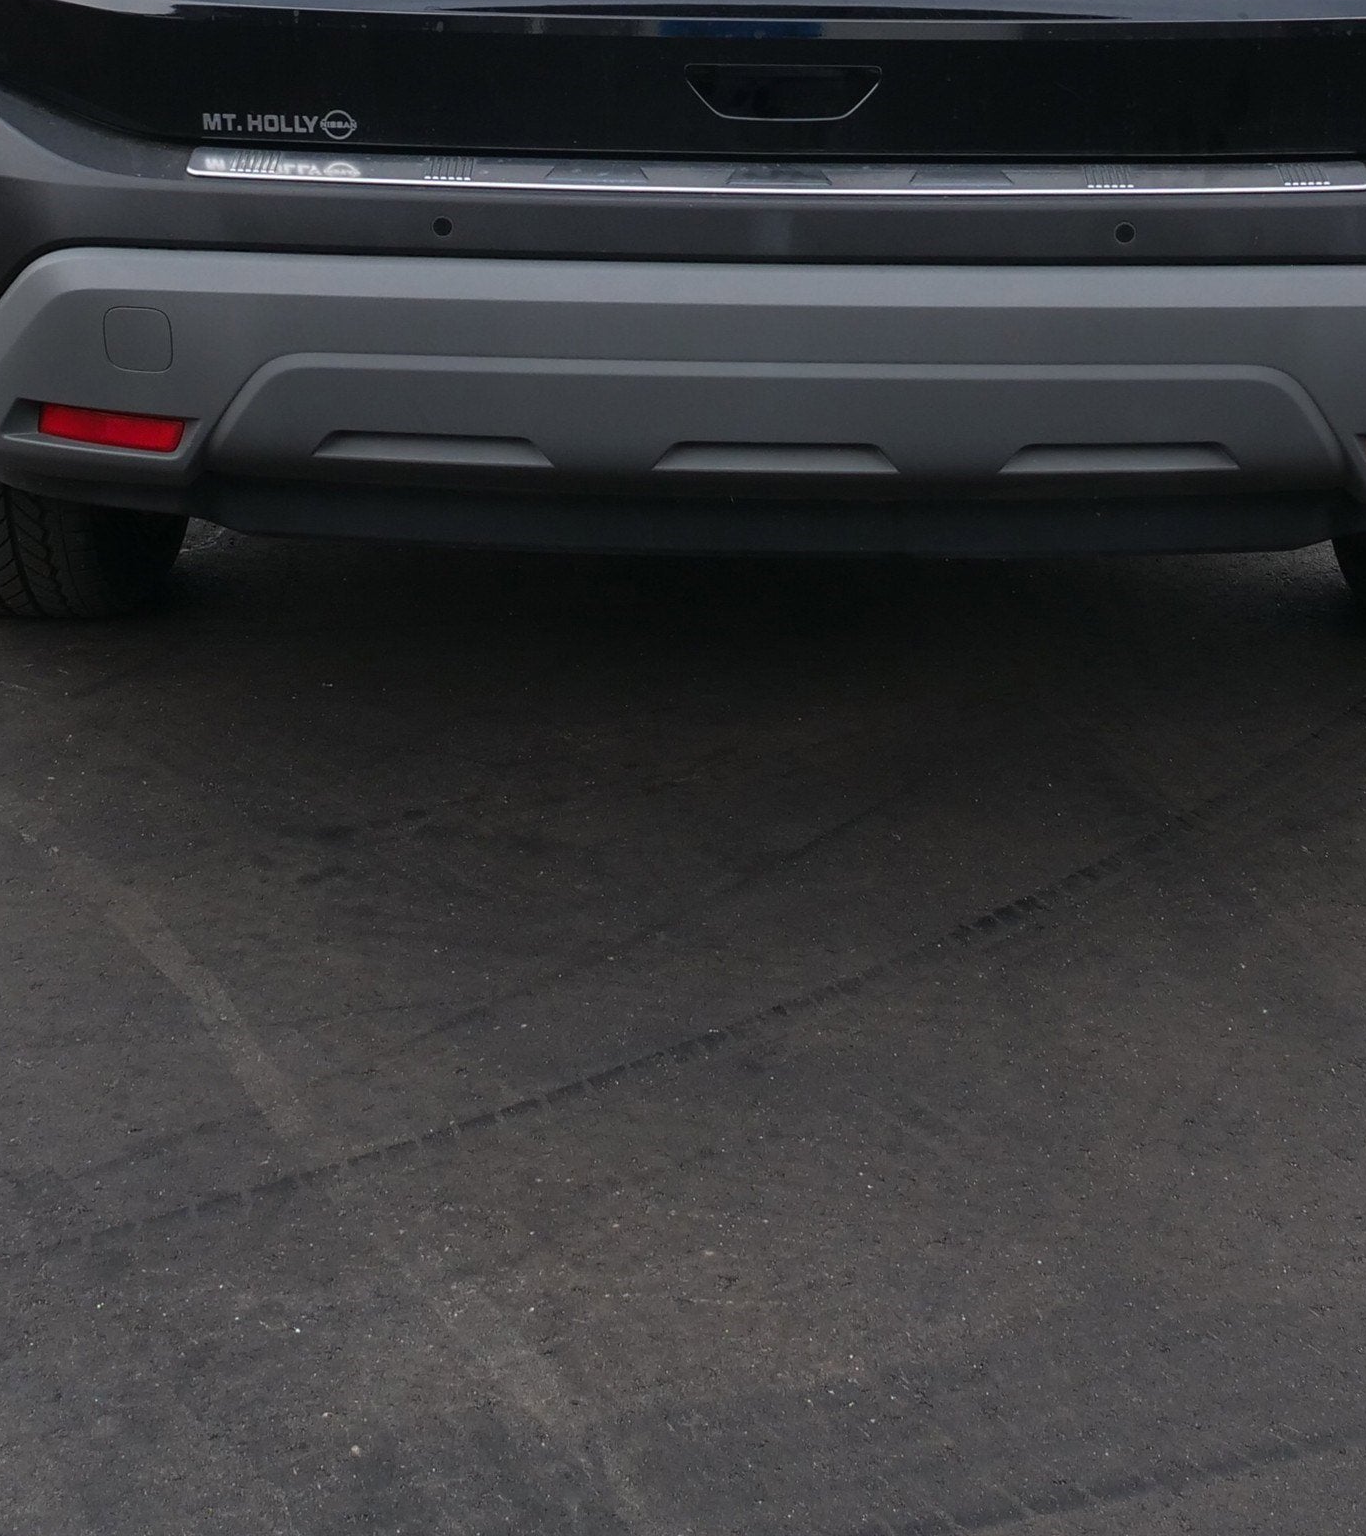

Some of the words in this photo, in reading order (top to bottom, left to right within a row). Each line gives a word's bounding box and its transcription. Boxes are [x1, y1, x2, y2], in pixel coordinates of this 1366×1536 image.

[202, 113, 243, 132] MT.
[247, 114, 319, 134] HOLLY
[319, 119, 358, 130] NISSAN
